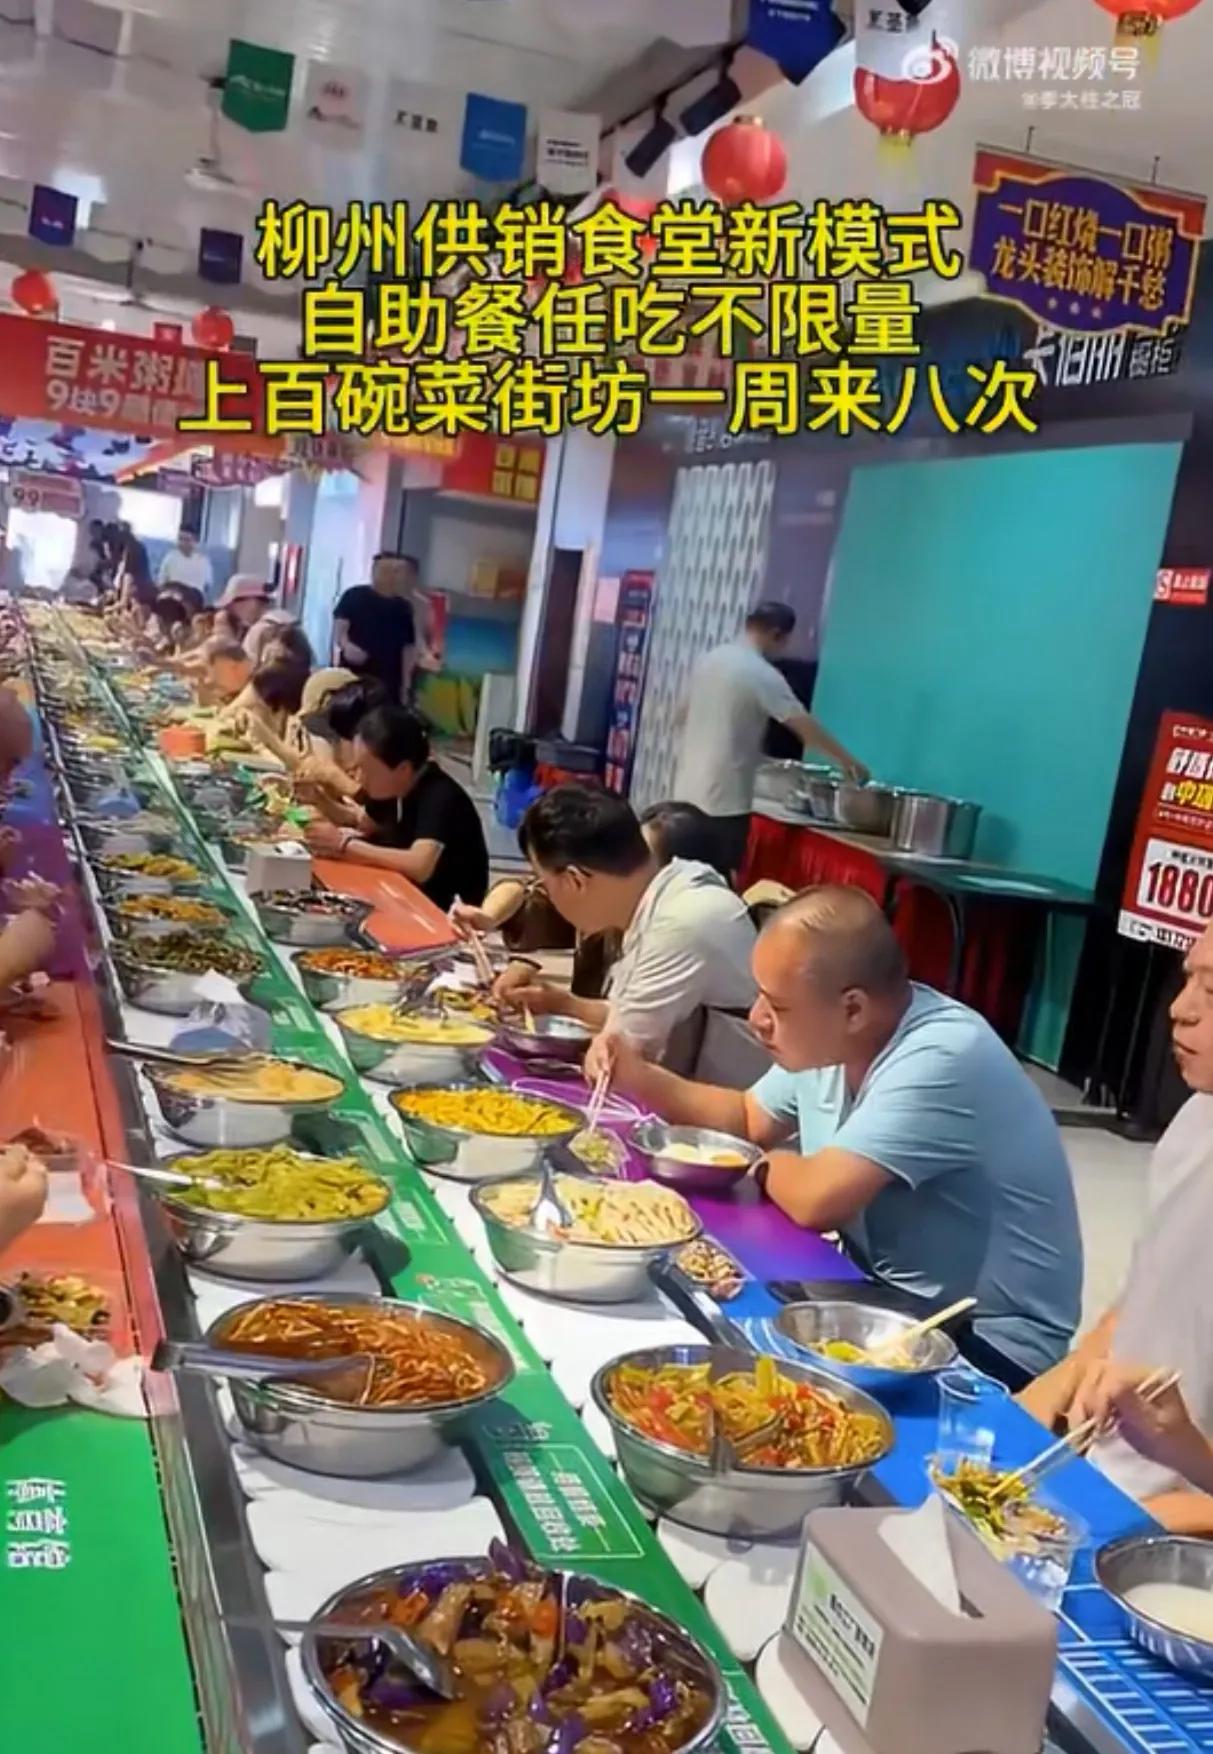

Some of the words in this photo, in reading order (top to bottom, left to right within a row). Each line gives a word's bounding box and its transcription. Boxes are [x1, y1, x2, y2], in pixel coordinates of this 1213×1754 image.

[998, 199, 1174, 269] 一口红烧一口粥
[991, 236, 1167, 310] 龙头装饰解千愁
